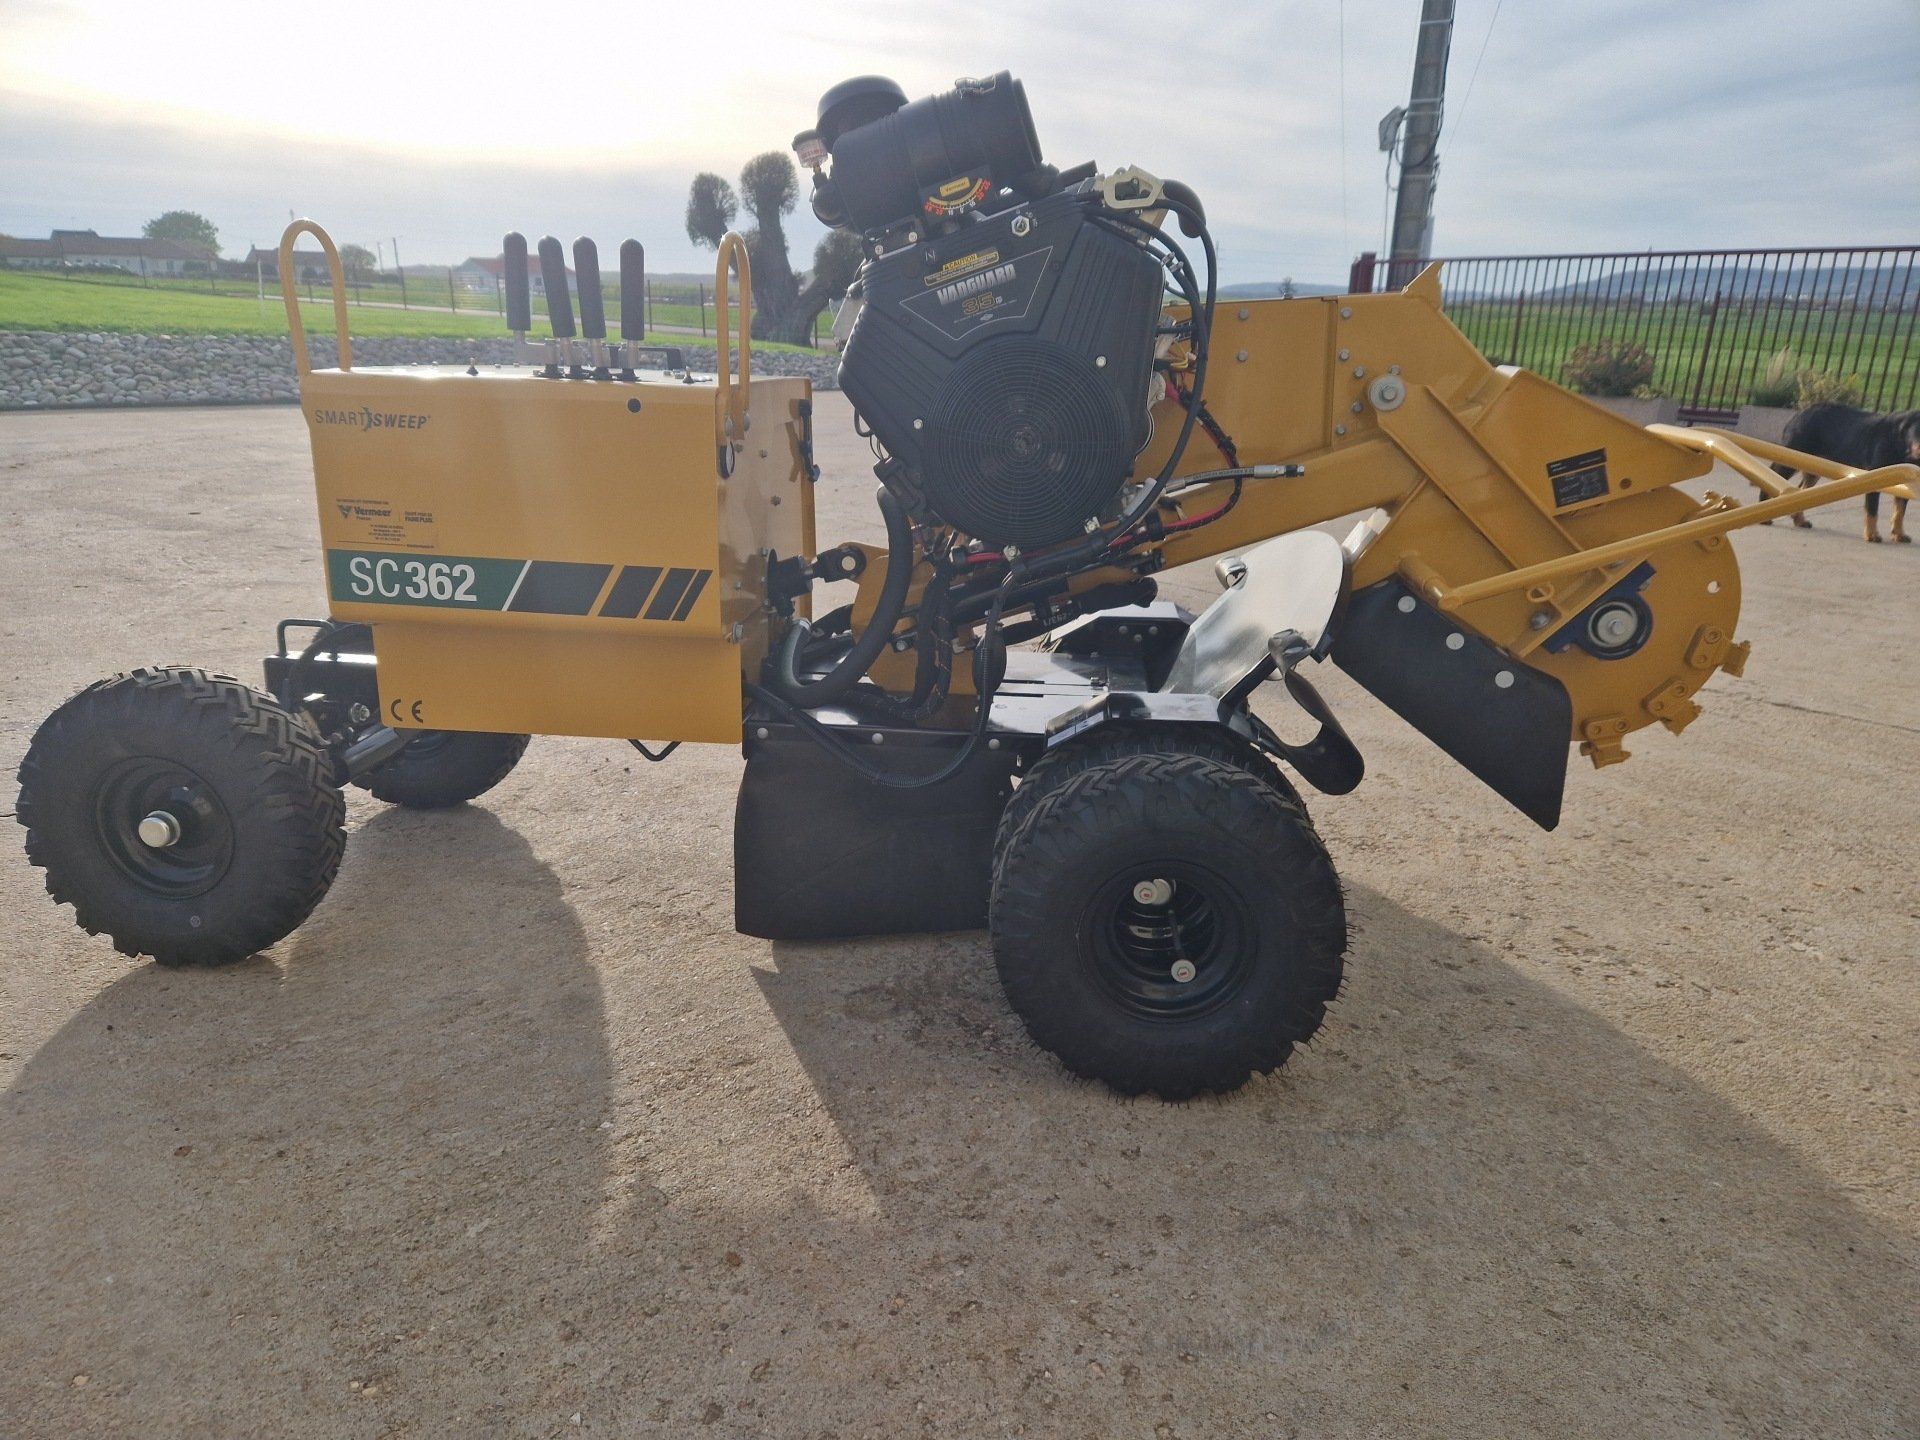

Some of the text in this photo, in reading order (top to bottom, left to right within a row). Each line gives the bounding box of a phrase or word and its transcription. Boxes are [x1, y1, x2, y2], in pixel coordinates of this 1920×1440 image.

[948, 254, 977, 269] CAUTION
[937, 264, 1017, 305] VANGUARD
[962, 292, 995, 315] 35
[354, 506, 392, 517] Vermeer
[350, 557, 477, 601] SC362
